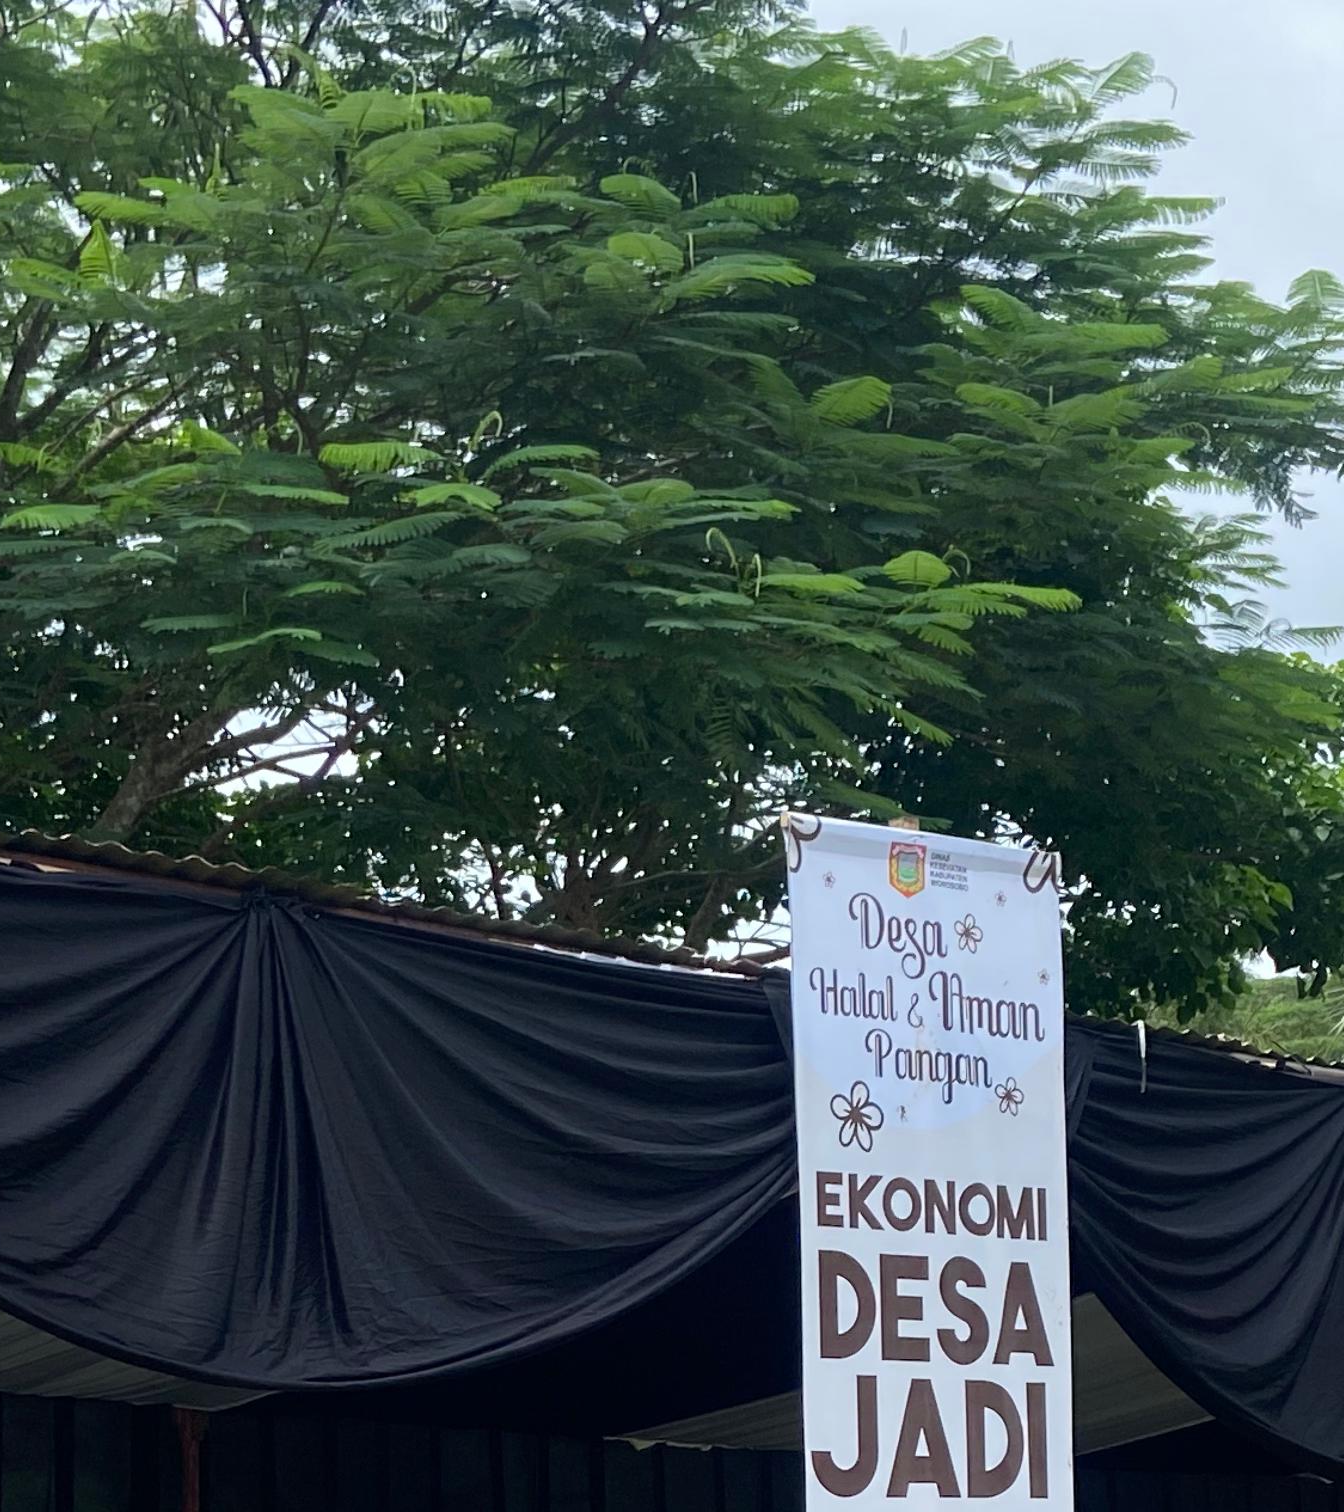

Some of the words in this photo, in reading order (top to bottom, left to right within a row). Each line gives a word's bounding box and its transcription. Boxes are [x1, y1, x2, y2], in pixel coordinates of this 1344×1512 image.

[849, 893, 947, 979] Desa
[809, 967, 897, 1022] Halal
[907, 993, 923, 1028] &
[929, 971, 1045, 1041] Aman
[865, 1028, 993, 1104] Pangan
[816, 1171, 1048, 1241] EKONOMI
[818, 1249, 1055, 1367] DESA
[811, 1375, 1048, 1499] JADI
